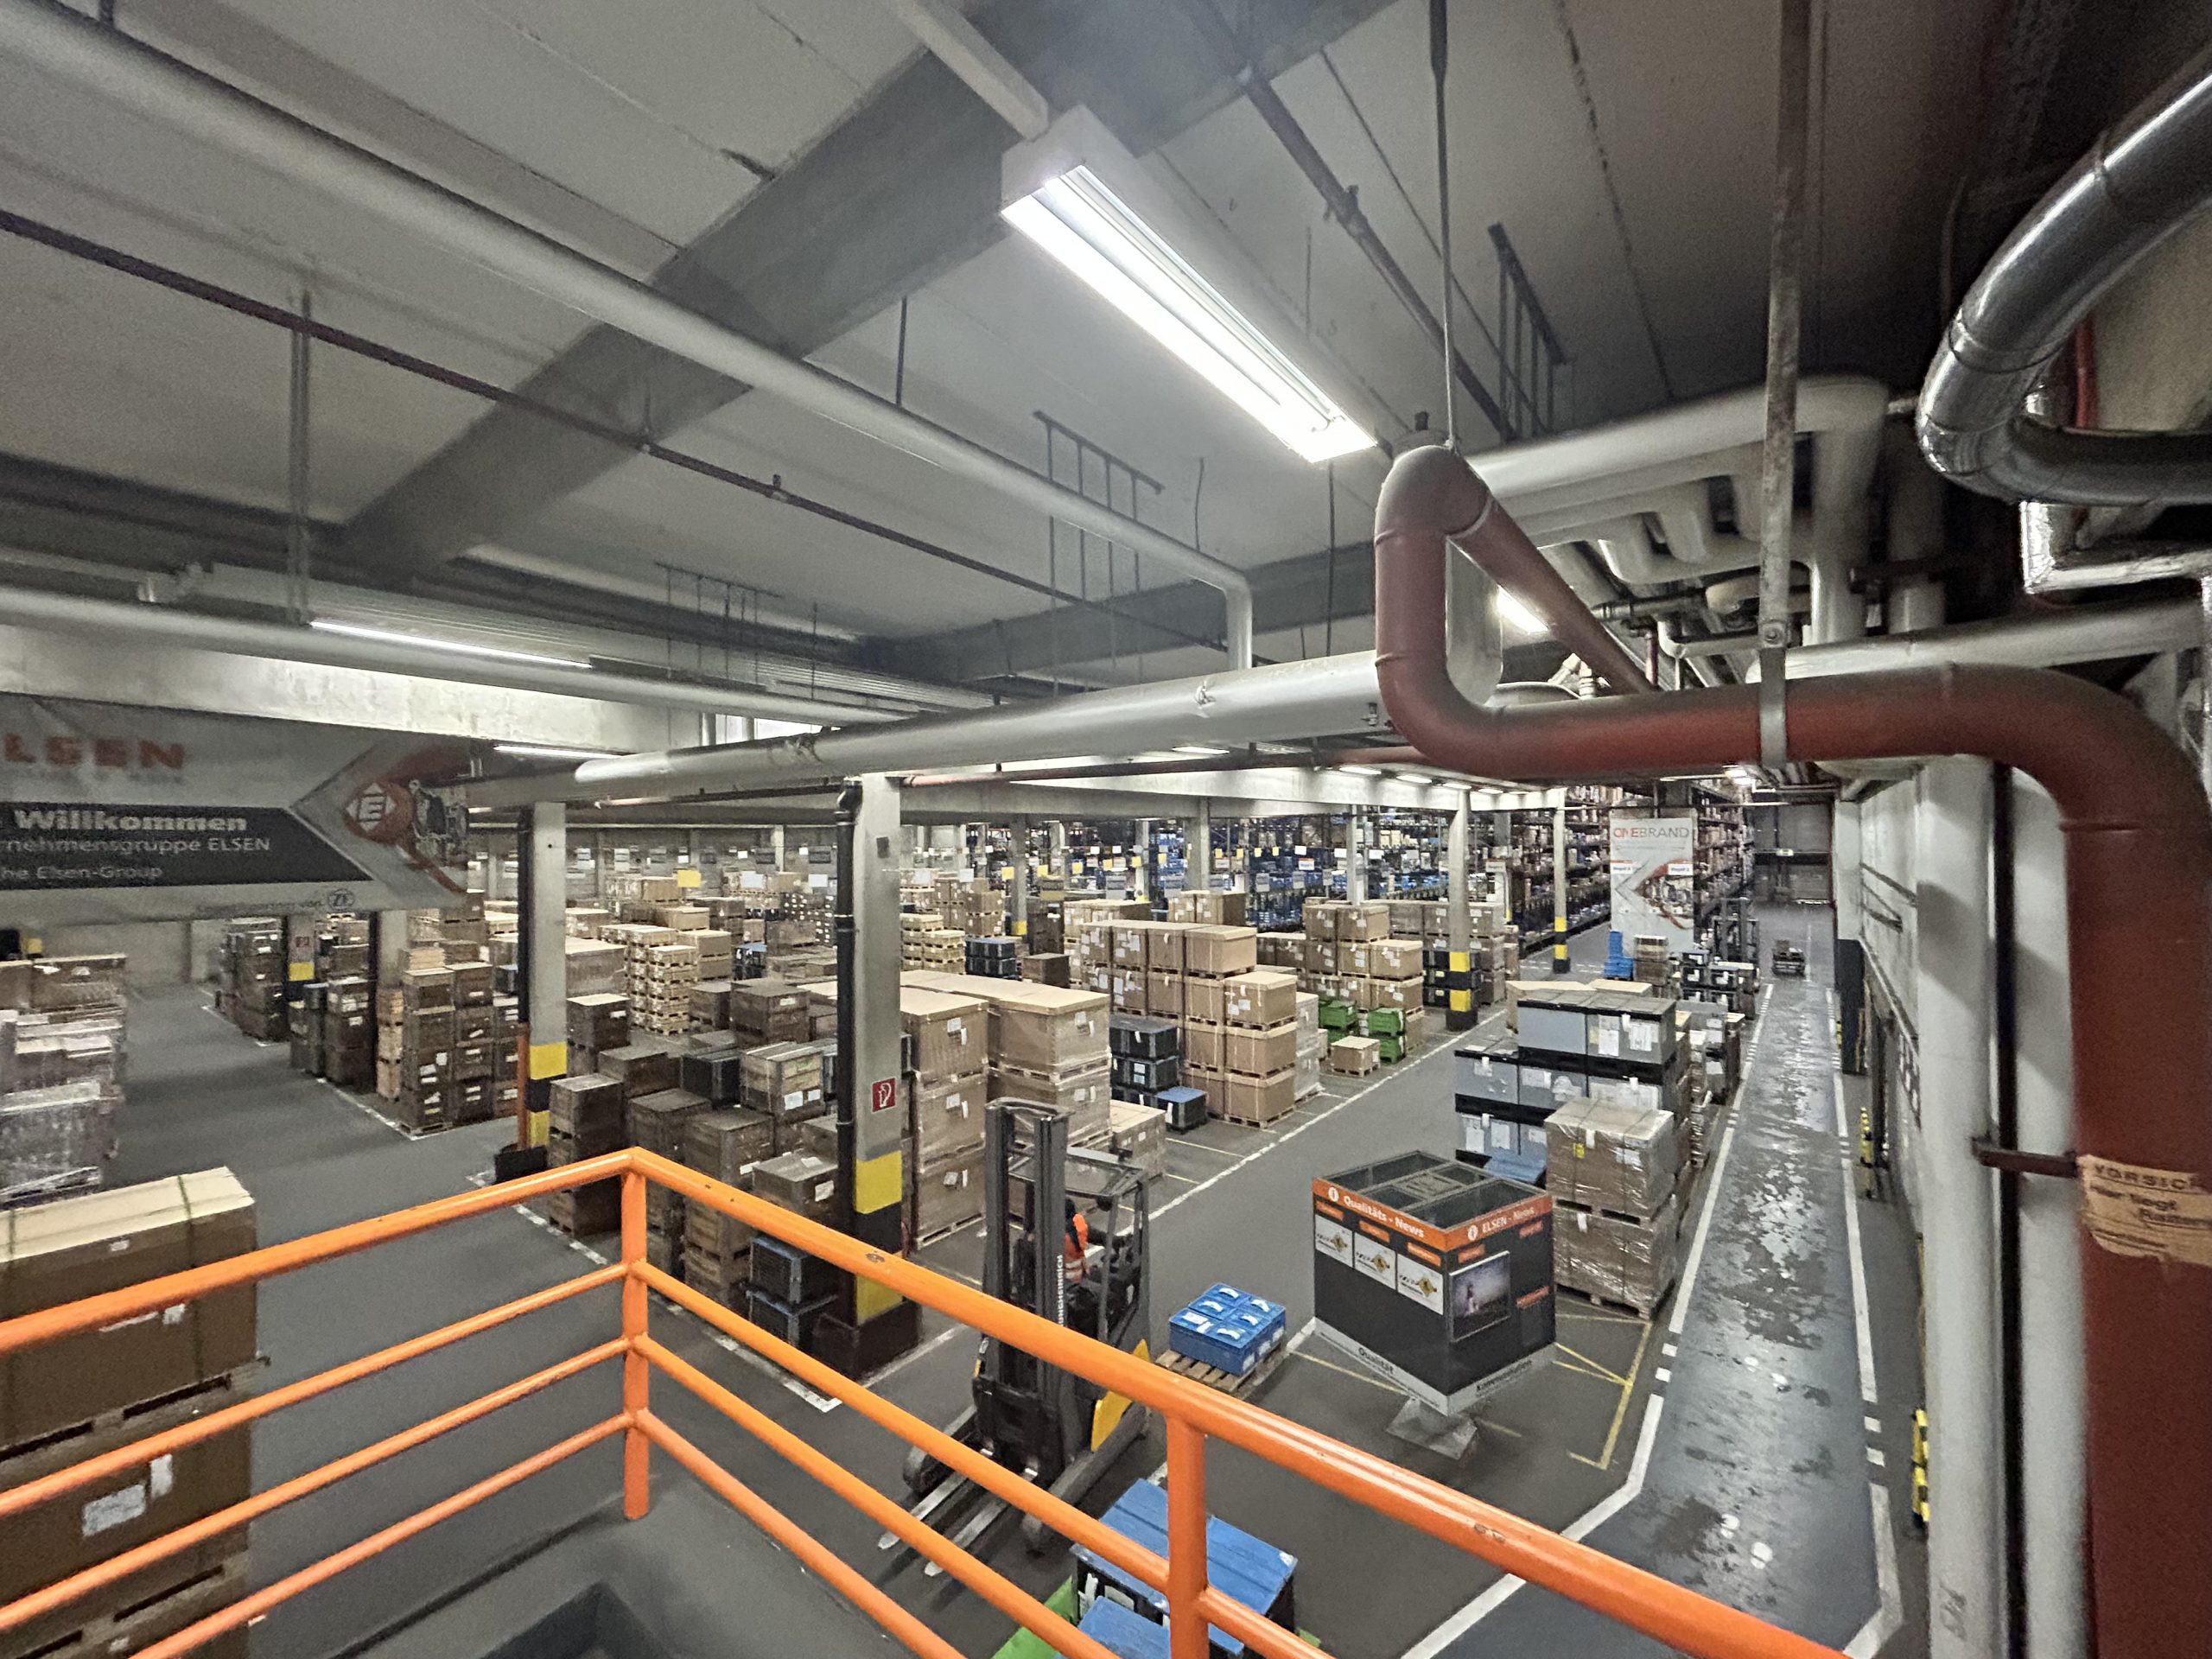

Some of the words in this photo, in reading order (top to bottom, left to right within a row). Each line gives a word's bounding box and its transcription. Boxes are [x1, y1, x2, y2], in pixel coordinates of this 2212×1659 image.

[14, 810, 247, 831] Willkommen
[208, 837, 270, 851] ELSEN
[1343, 1195, 1388, 1223] Qualitäts
[1395, 1217, 1425, 1238] News
[1482, 1216, 1508, 1234] ELSEN
